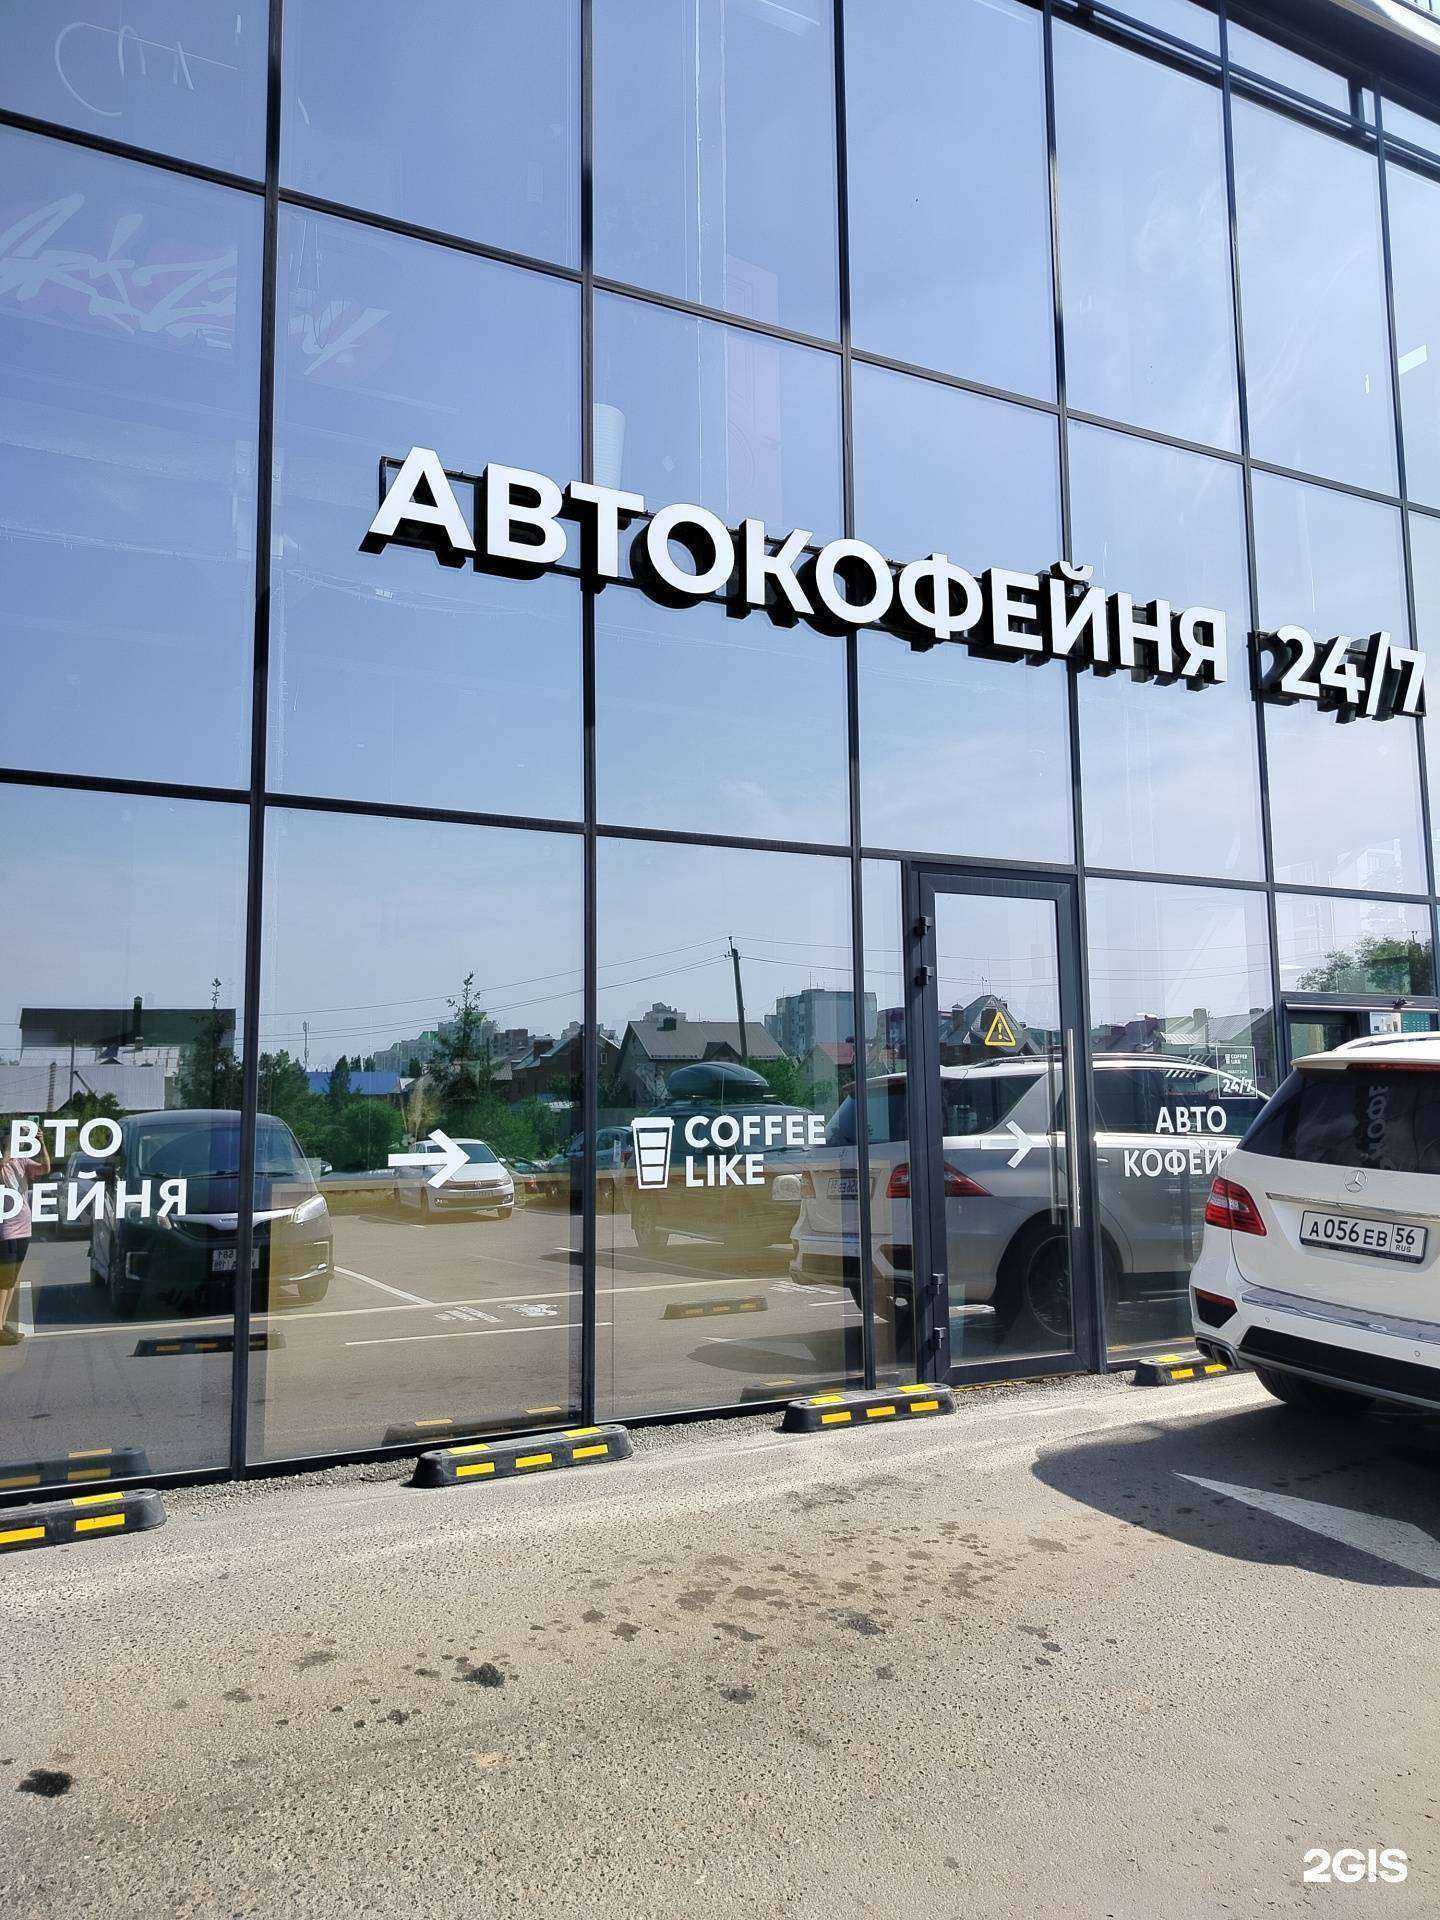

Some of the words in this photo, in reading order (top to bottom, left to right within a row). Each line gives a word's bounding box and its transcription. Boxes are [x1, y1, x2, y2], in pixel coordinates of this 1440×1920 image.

[368, 446, 1228, 682] АВТОКОФЕЙНЯ
[1281, 624, 1427, 716] 24/7
[684, 1114, 827, 1148] COFFEE
[1155, 1105, 1228, 1134] АВТО
[0, 1117, 123, 1159] ВТО
[685, 1153, 766, 1188] LIKE
[1123, 1143, 1229, 1178] КОФЕЙ
[1394, 1227, 1415, 1246] 56
[1395, 1245, 1412, 1253] RUS
